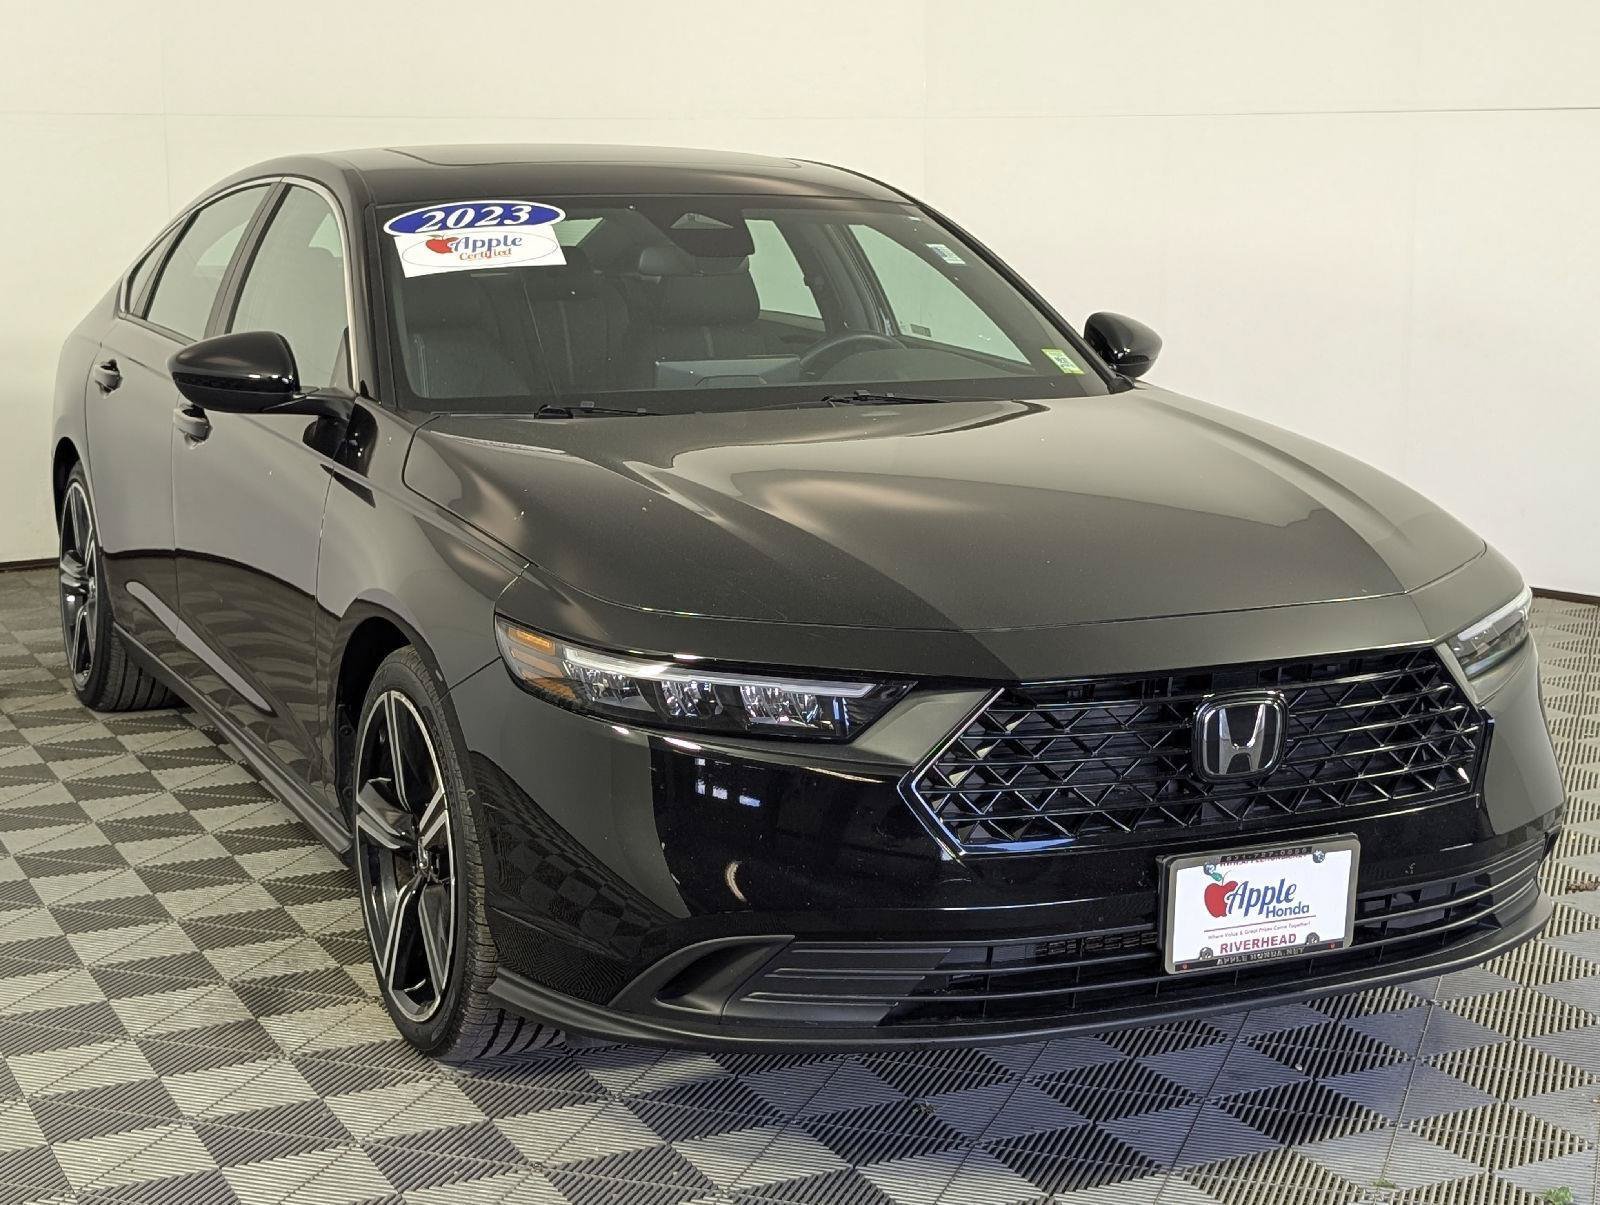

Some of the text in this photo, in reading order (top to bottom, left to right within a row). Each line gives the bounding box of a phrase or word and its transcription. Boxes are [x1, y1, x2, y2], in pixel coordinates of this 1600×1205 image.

[415, 205, 532, 233] 2023
[450, 235, 522, 254] Apple
[459, 248, 512, 261] Certified
[1226, 878, 1297, 917] Apple
[1265, 902, 1310, 918] Honda
[1220, 933, 1297, 954] RIVERHEAD
[1216, 954, 1249, 966] APPLE
